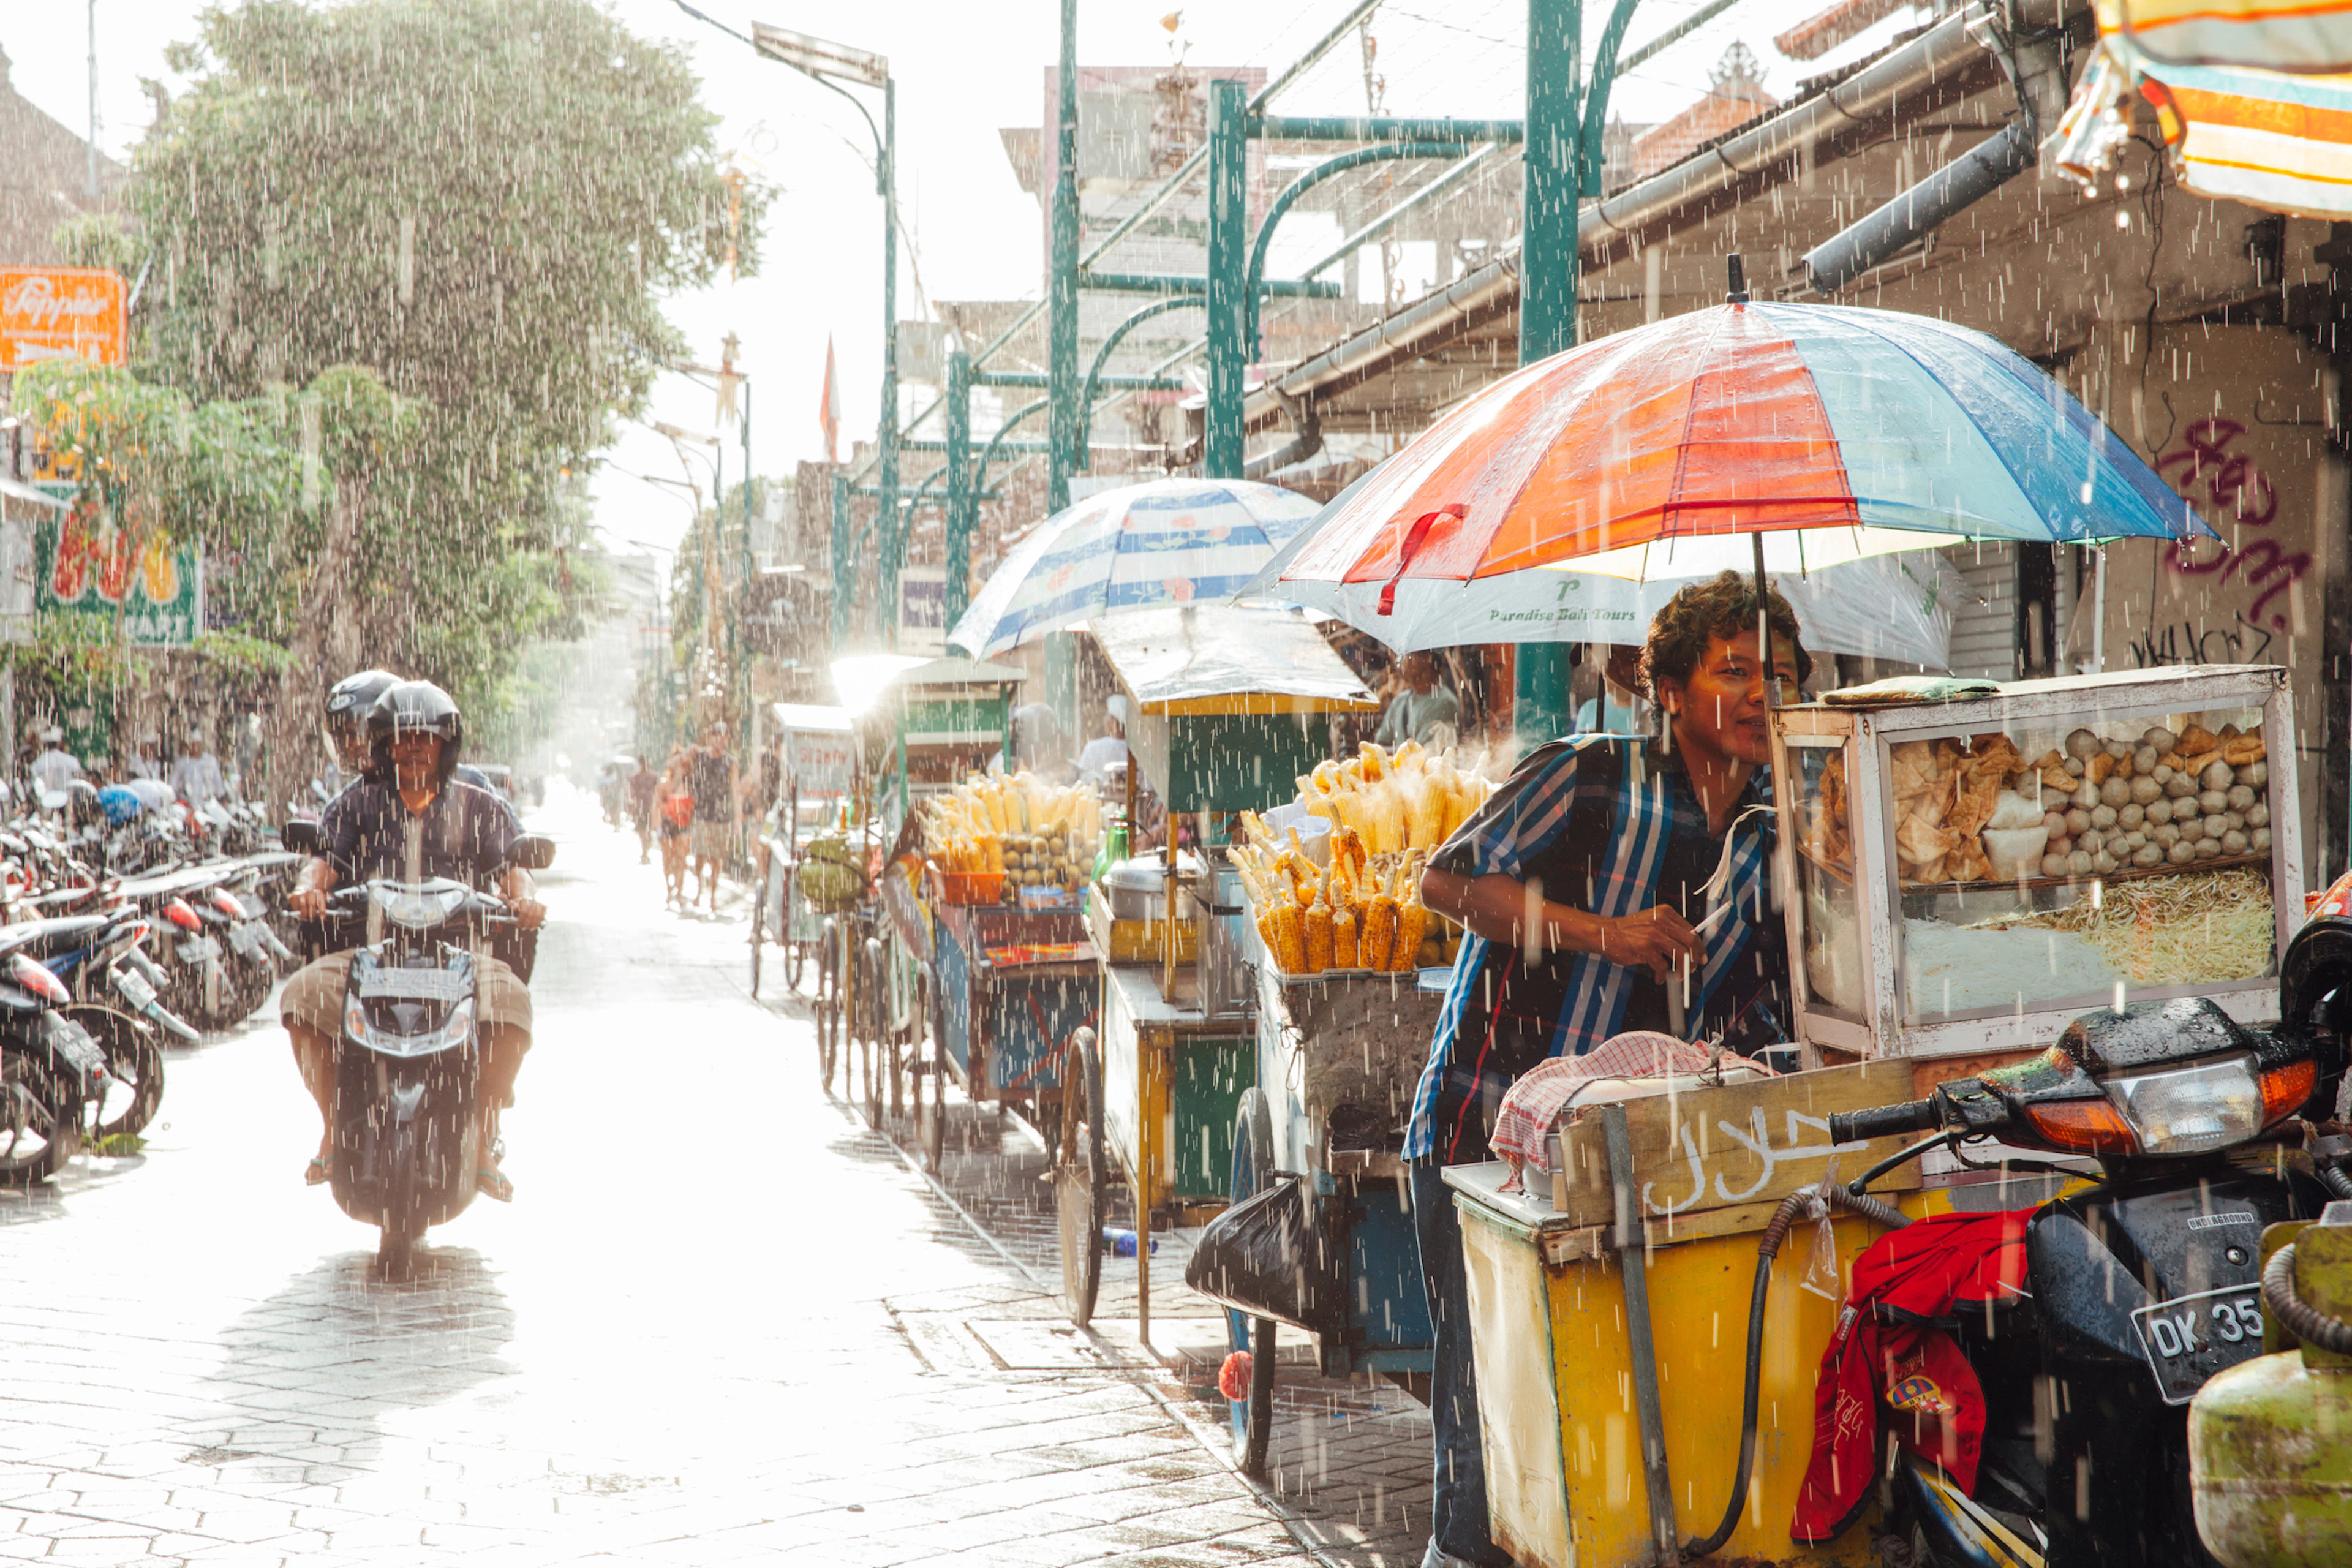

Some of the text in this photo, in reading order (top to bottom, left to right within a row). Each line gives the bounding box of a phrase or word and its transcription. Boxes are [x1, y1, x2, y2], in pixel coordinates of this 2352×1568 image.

[1489, 607, 1637, 622] Paradise Bali Tours
[2188, 1213, 2253, 1229] UNDERGROUND
[2149, 1311, 2199, 1357] DK
